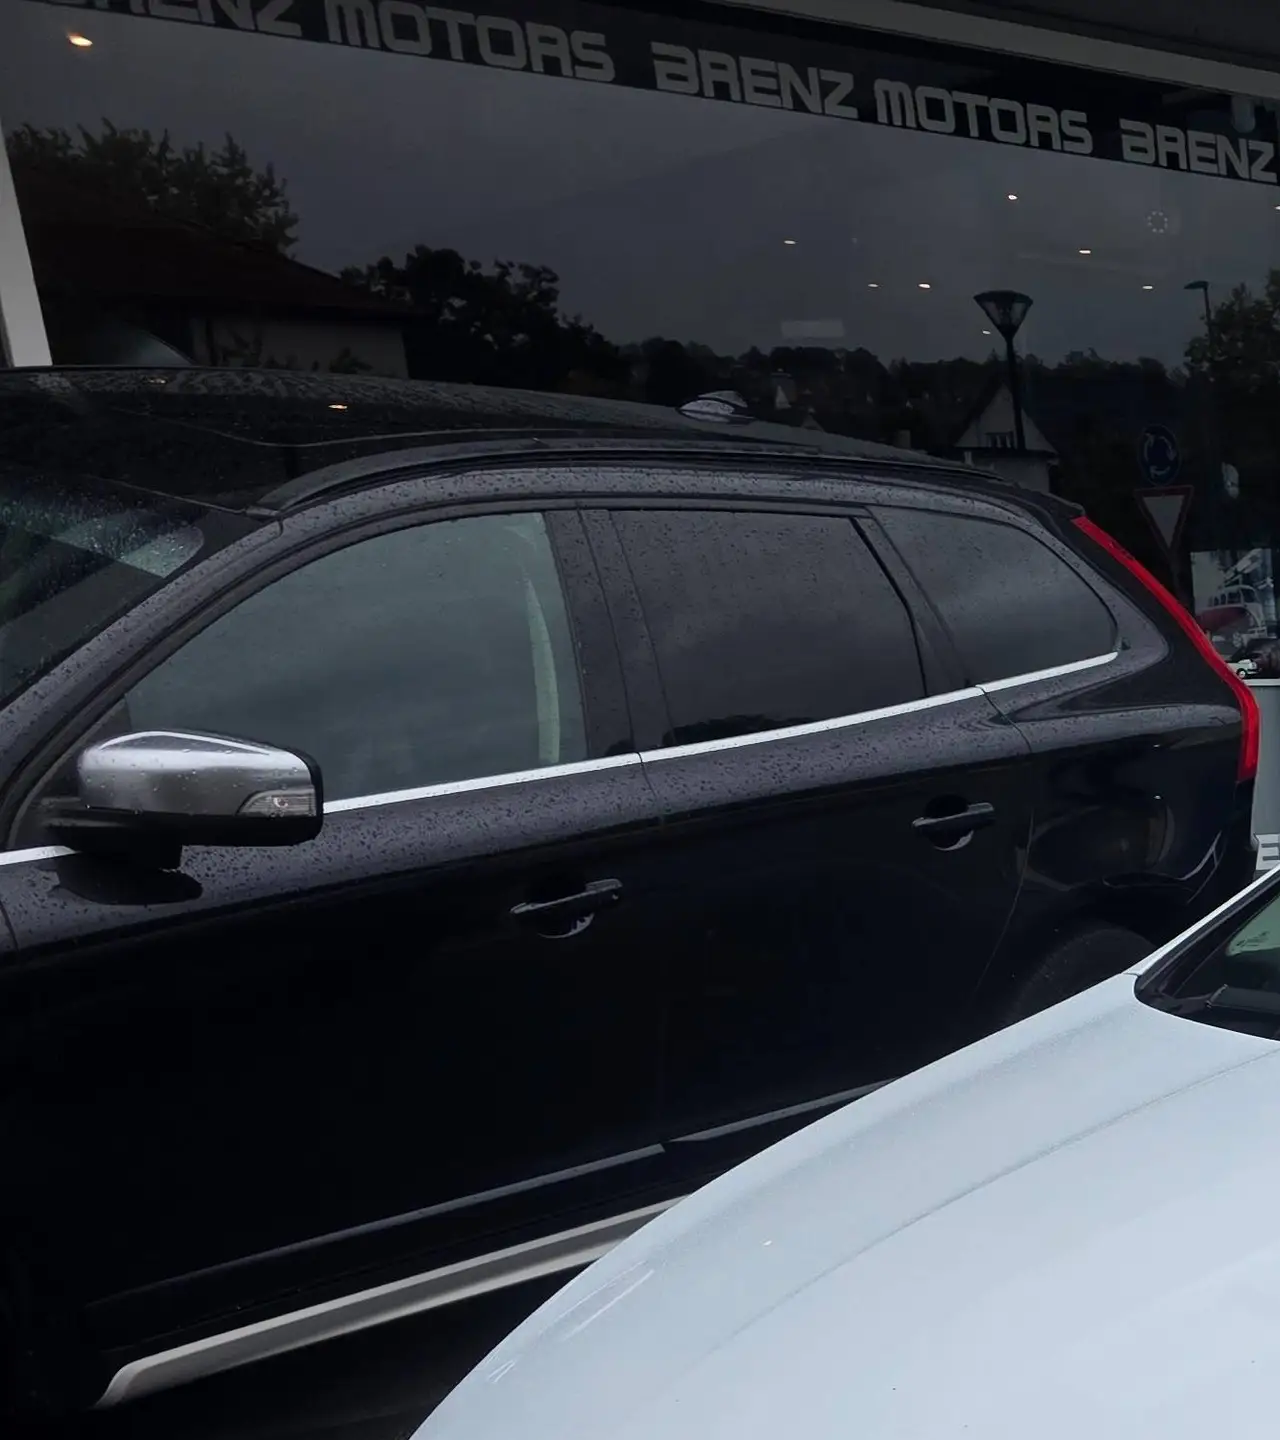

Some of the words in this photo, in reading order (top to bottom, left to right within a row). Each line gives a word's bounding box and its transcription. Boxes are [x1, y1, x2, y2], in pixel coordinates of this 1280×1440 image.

[325, 0, 615, 84] MOTORS
[651, 41, 859, 119] BRENZ
[875, 78, 1093, 155] MOTORS
[1119, 118, 1278, 183] BRENZ
